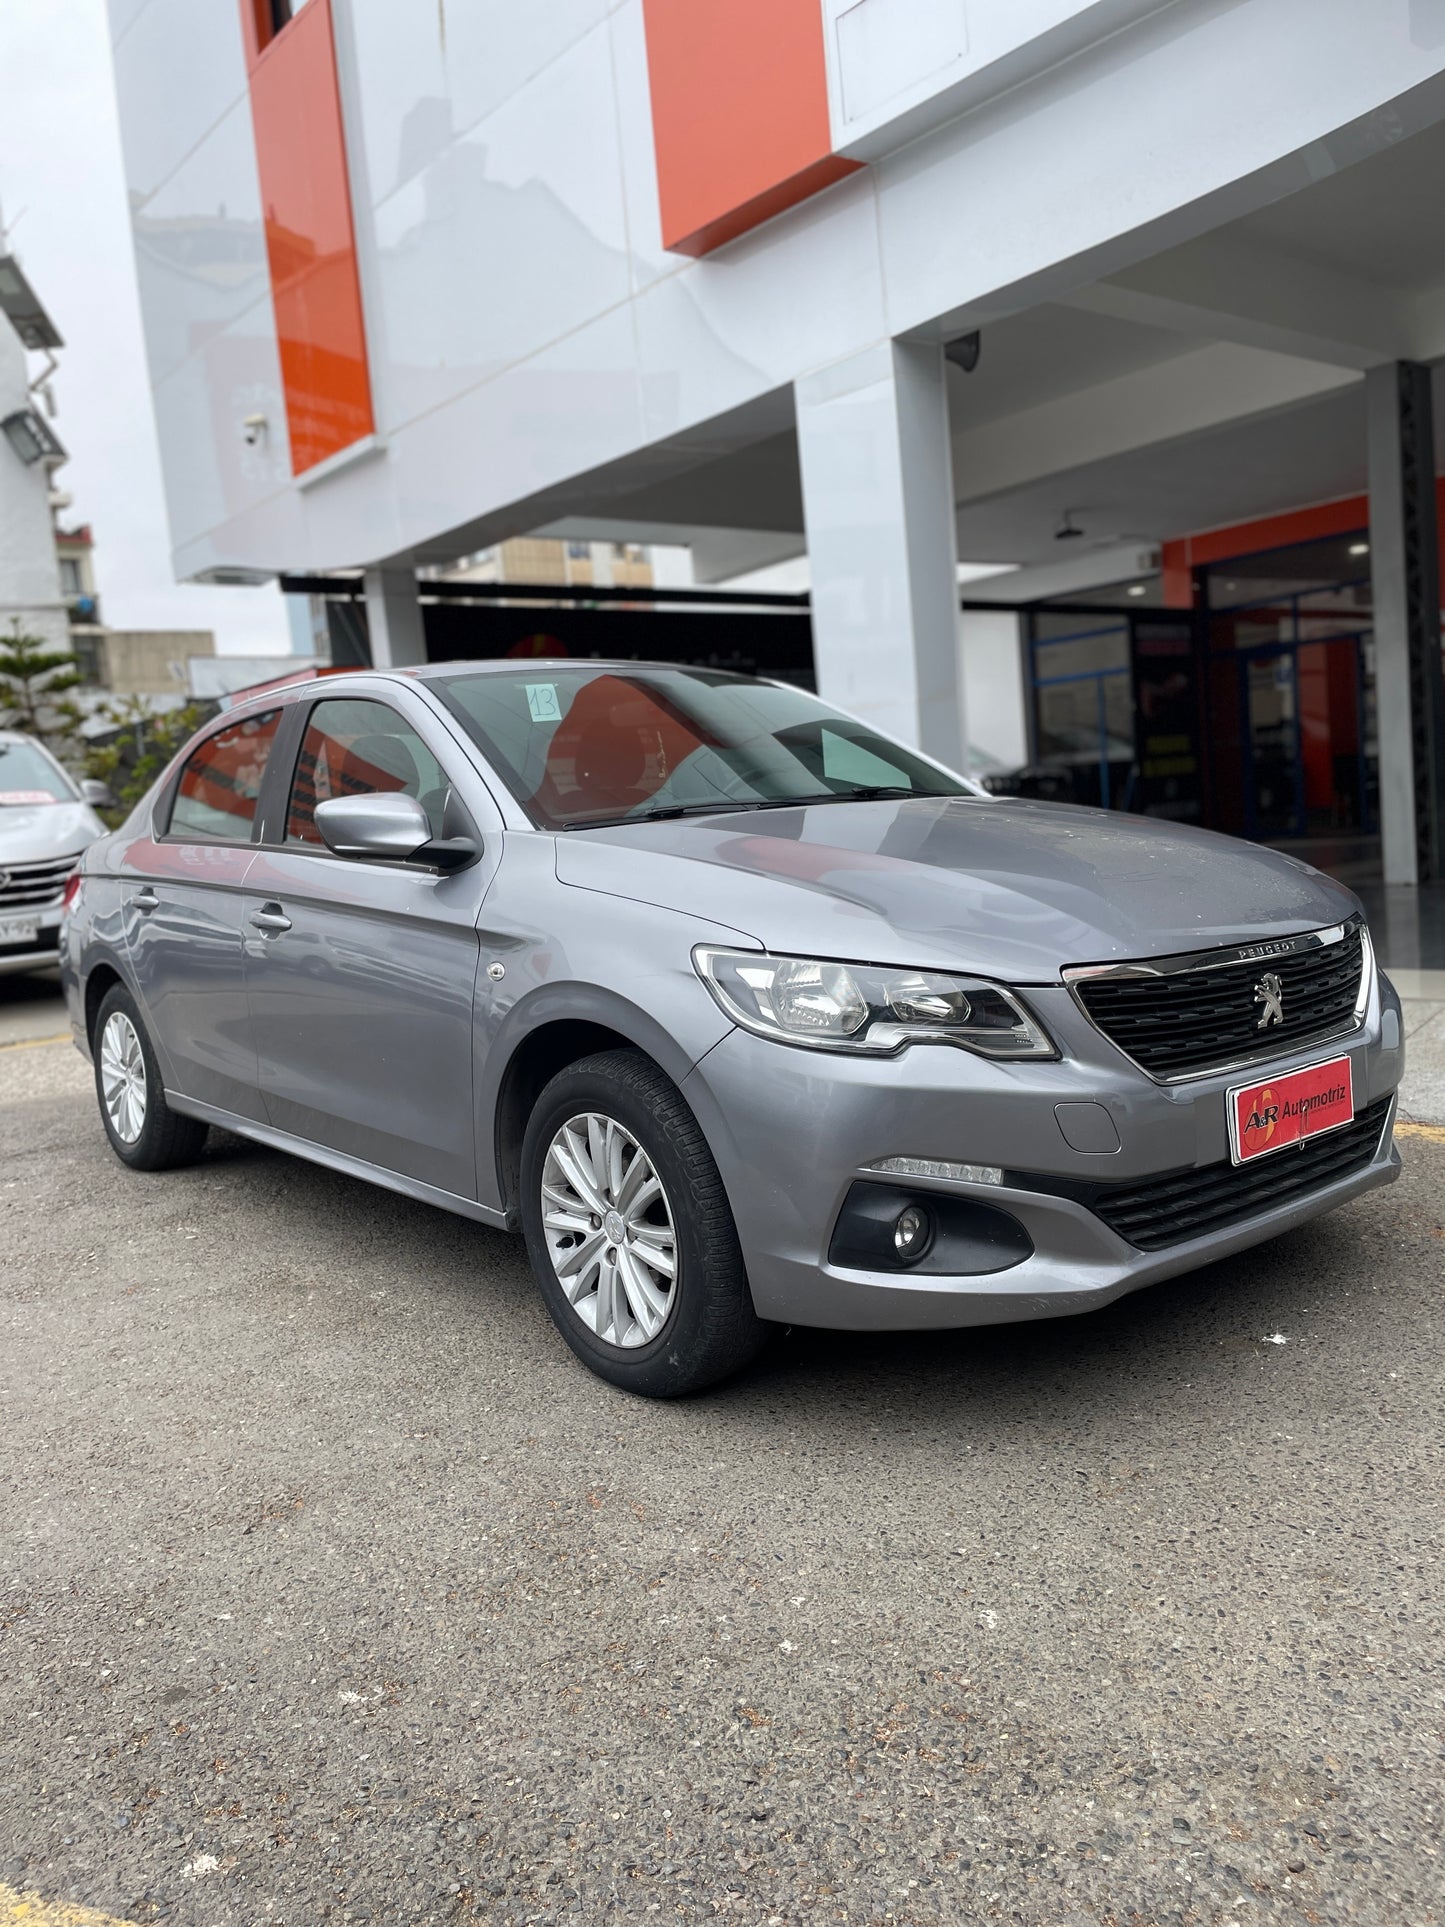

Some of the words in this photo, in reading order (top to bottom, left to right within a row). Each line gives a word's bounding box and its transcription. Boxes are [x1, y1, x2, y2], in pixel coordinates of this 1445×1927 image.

[530, 687, 557, 717] 13
[1238, 941, 1296, 960] PEUGEOT
[1281, 1084, 1346, 1119] Automotriz
